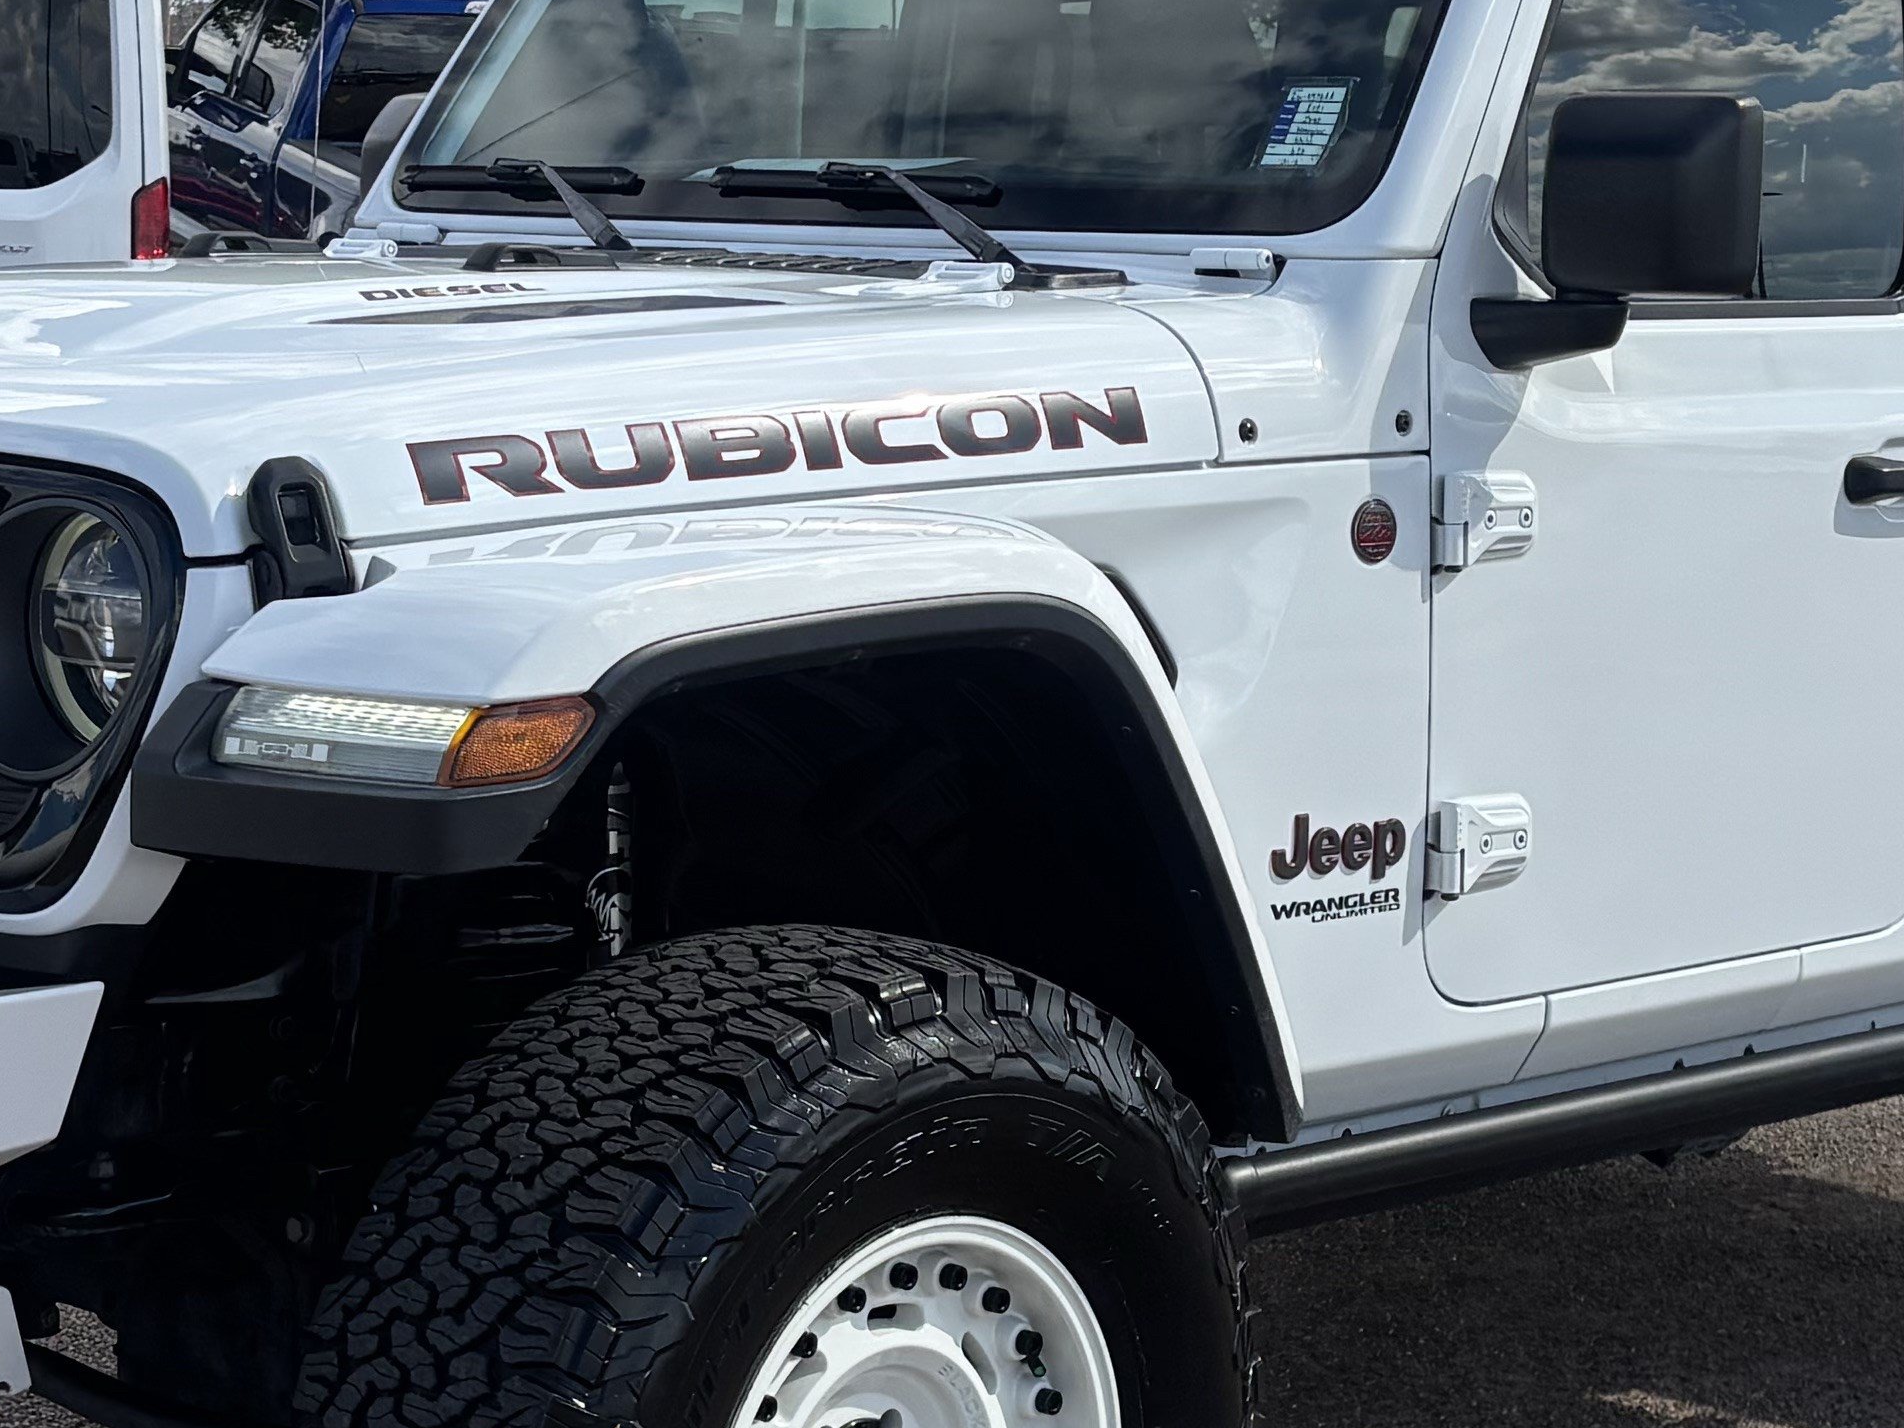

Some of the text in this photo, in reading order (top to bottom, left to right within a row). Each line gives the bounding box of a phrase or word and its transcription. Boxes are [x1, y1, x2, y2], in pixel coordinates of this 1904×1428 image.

[358, 282, 546, 302] DIESEL
[405, 386, 1149, 506] RUBICON
[1270, 812, 1406, 880] Jeep
[1270, 887, 1400, 920] WRANGLER
[1311, 903, 1401, 923] UNLIMITED
